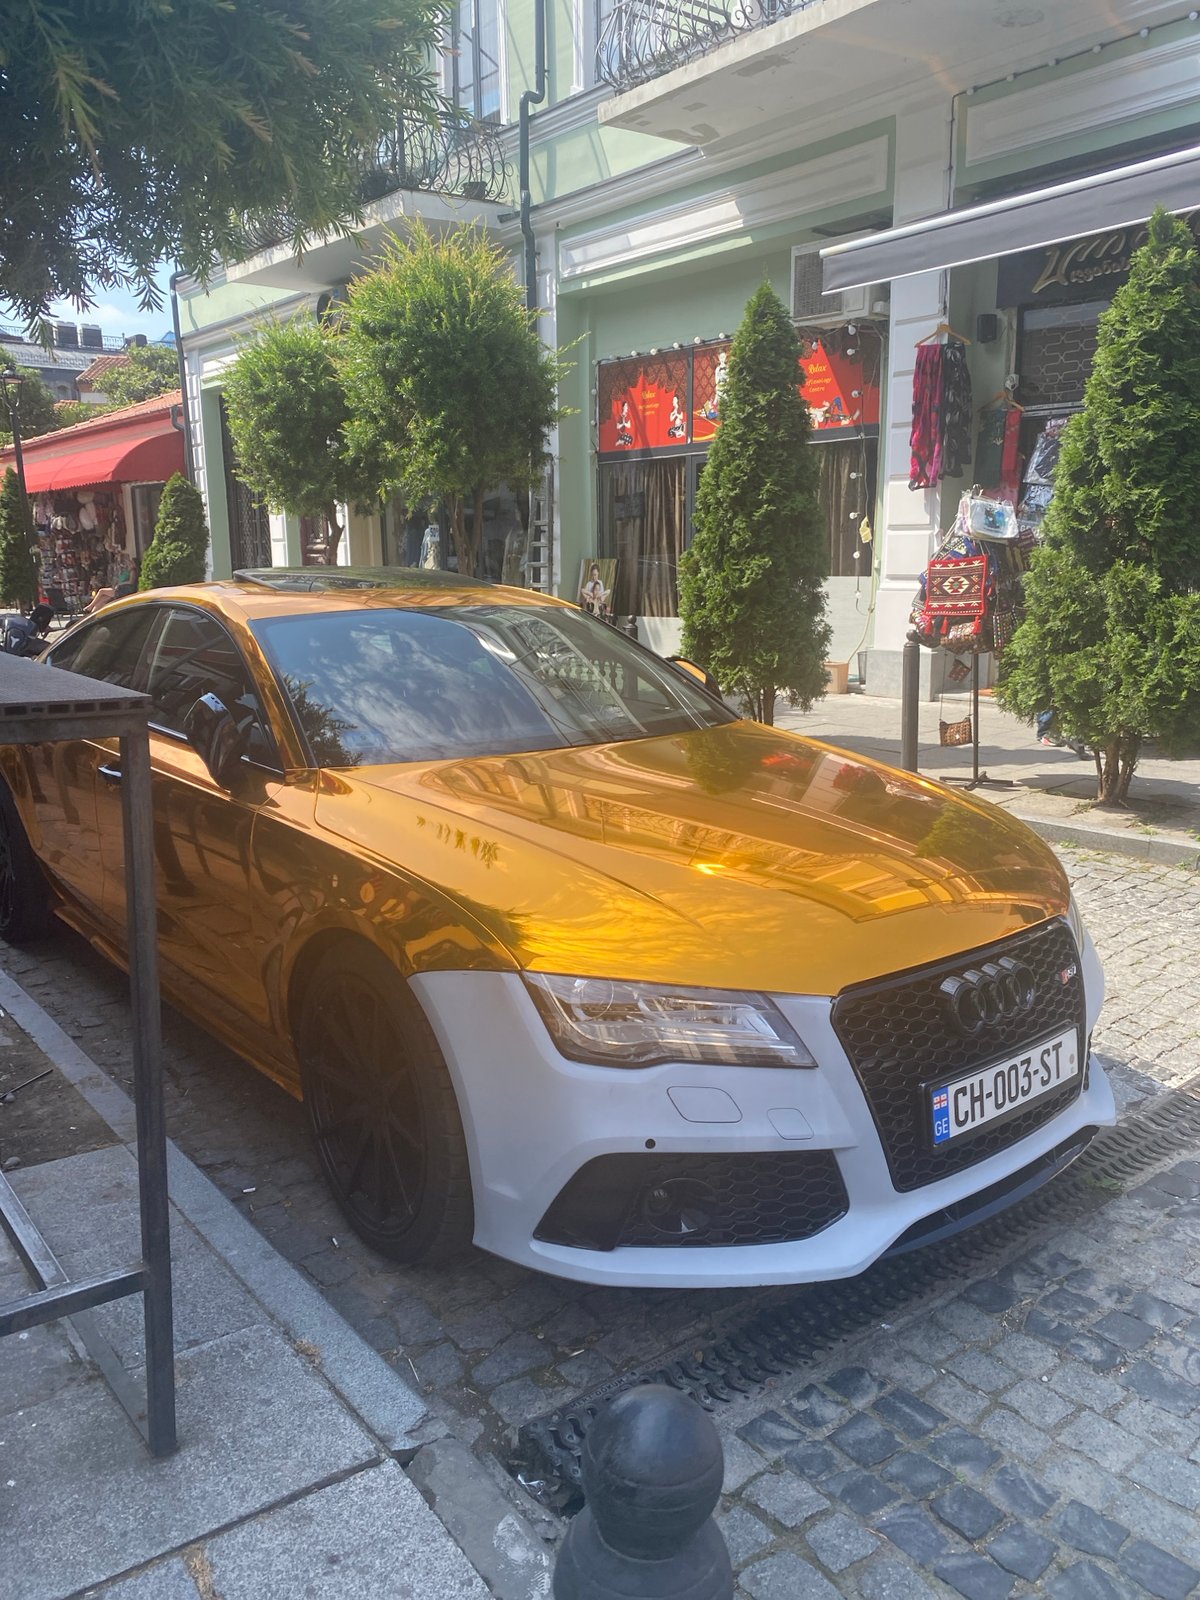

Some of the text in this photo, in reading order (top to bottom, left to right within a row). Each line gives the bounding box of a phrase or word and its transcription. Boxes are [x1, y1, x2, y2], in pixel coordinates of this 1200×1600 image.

[807, 362, 828, 375] Relax
[953, 1041, 1063, 1128] CH-003-ST
[934, 1116, 949, 1138] GE
